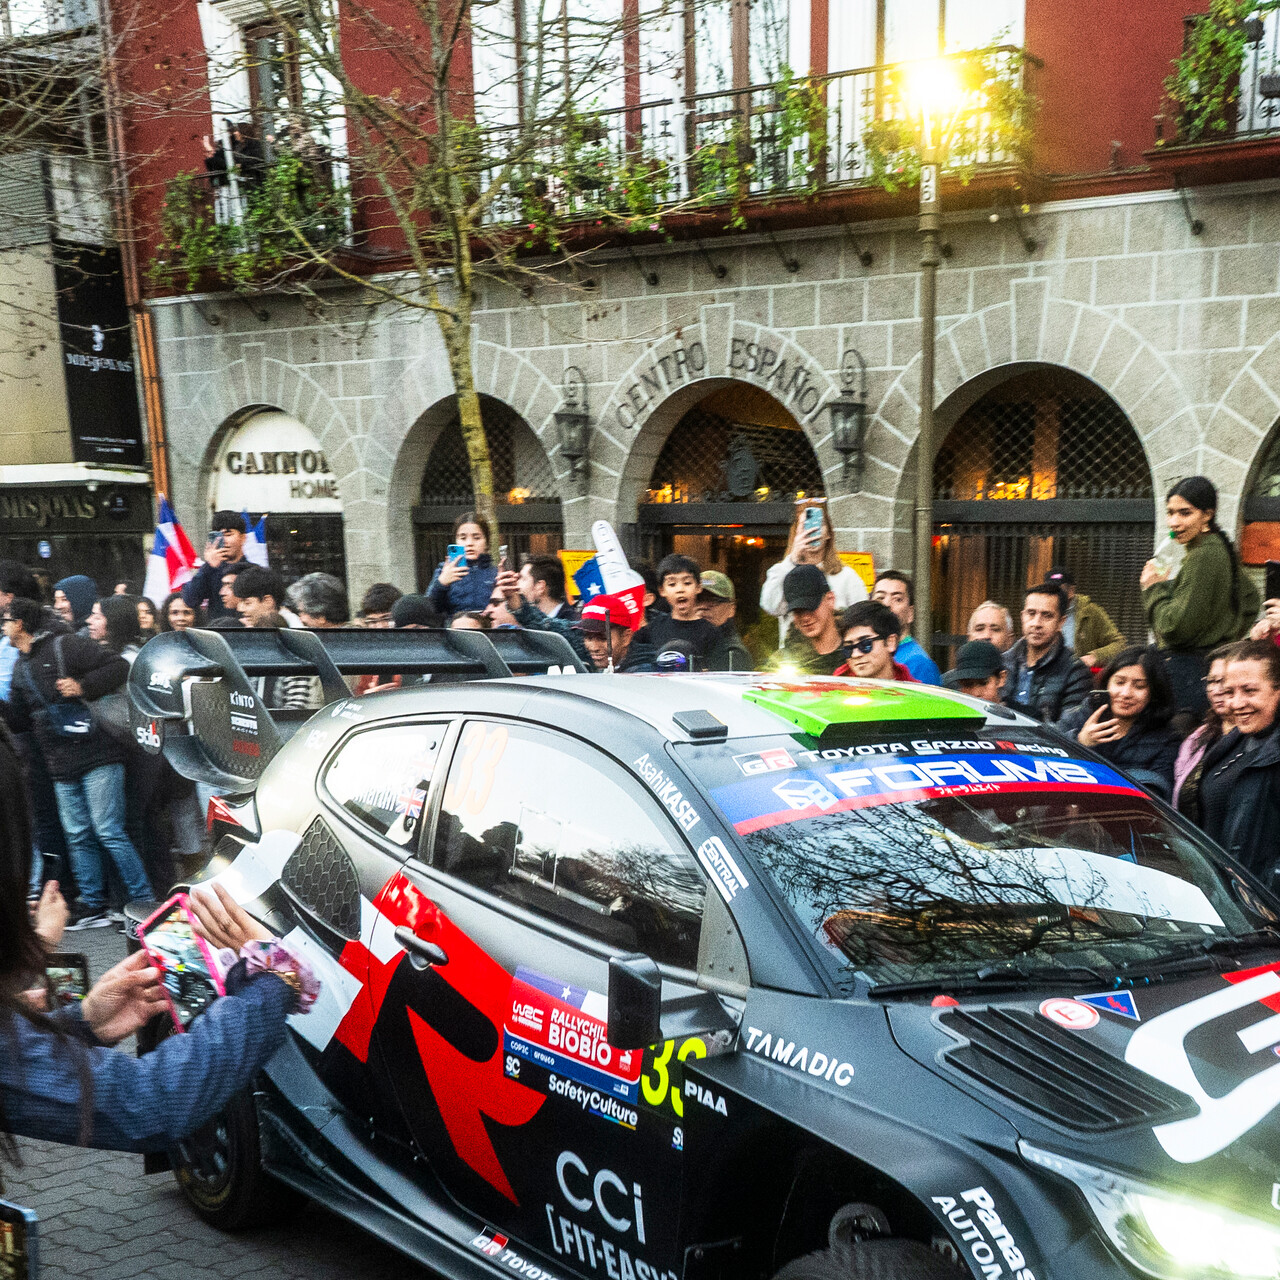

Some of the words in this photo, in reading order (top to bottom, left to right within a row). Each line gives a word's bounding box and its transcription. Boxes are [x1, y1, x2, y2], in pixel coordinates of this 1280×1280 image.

[614, 341, 707, 430] CENTRO
[728, 338, 828, 436] ESPAÑOL
[289, 478, 340, 499] HOME
[798, 742, 906, 762] TOYOTA
[911, 739, 996, 755] GAZOO
[996, 740, 1069, 757] Racing
[826, 760, 1100, 798] FORUM8
[701, 838, 741, 898] CENTRAL
[550, 1008, 608, 1042] RALLYCHIL
[505, 1056, 521, 1075] SC
[747, 1027, 855, 1086] TAMADIC
[548, 1073, 638, 1126] SafetyCulture
[684, 1079, 728, 1117] PIAA
